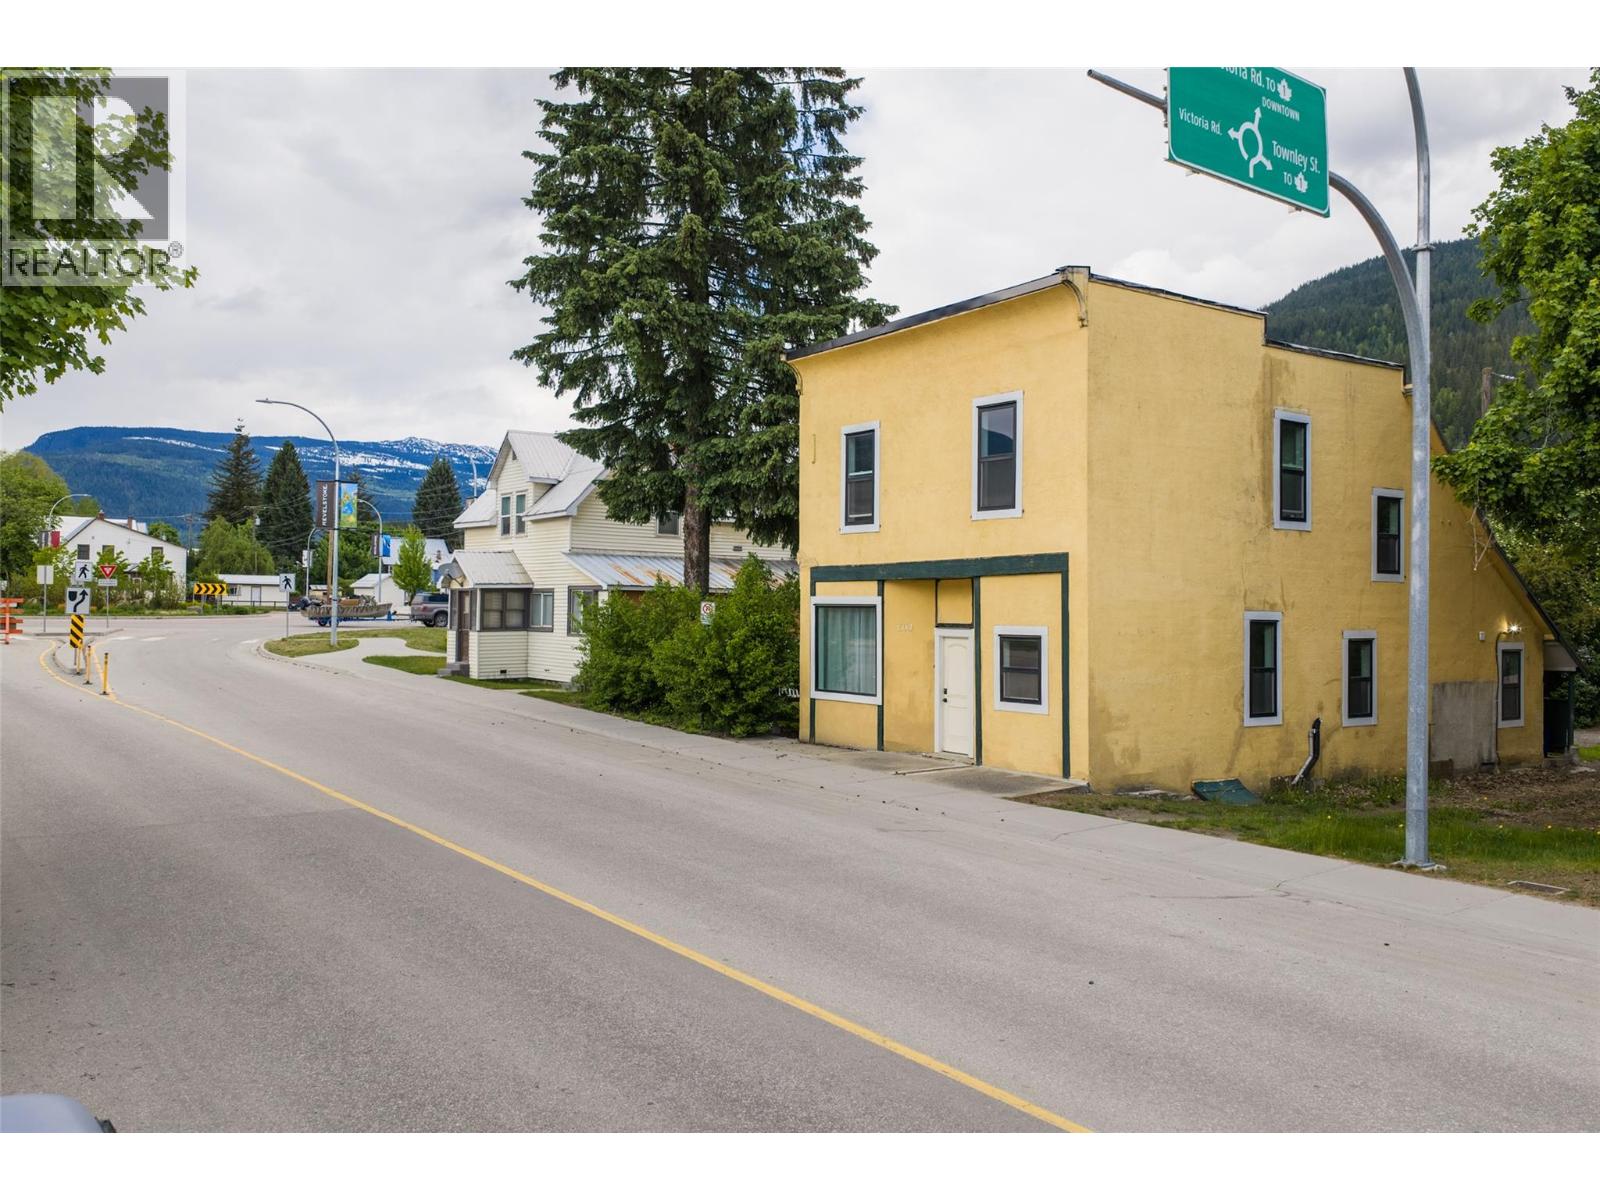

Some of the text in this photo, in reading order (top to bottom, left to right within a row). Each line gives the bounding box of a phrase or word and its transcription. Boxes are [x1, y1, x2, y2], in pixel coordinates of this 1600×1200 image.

[1250, 68, 1264, 88] Rd.
[1265, 77, 1276, 93] TO
[1262, 96, 1300, 121] DOWNTOWN
[1178, 107, 1223, 136] Victoria Rd.
[1271, 140, 1321, 174] Townley St.
[1283, 171, 1293, 186] TO
